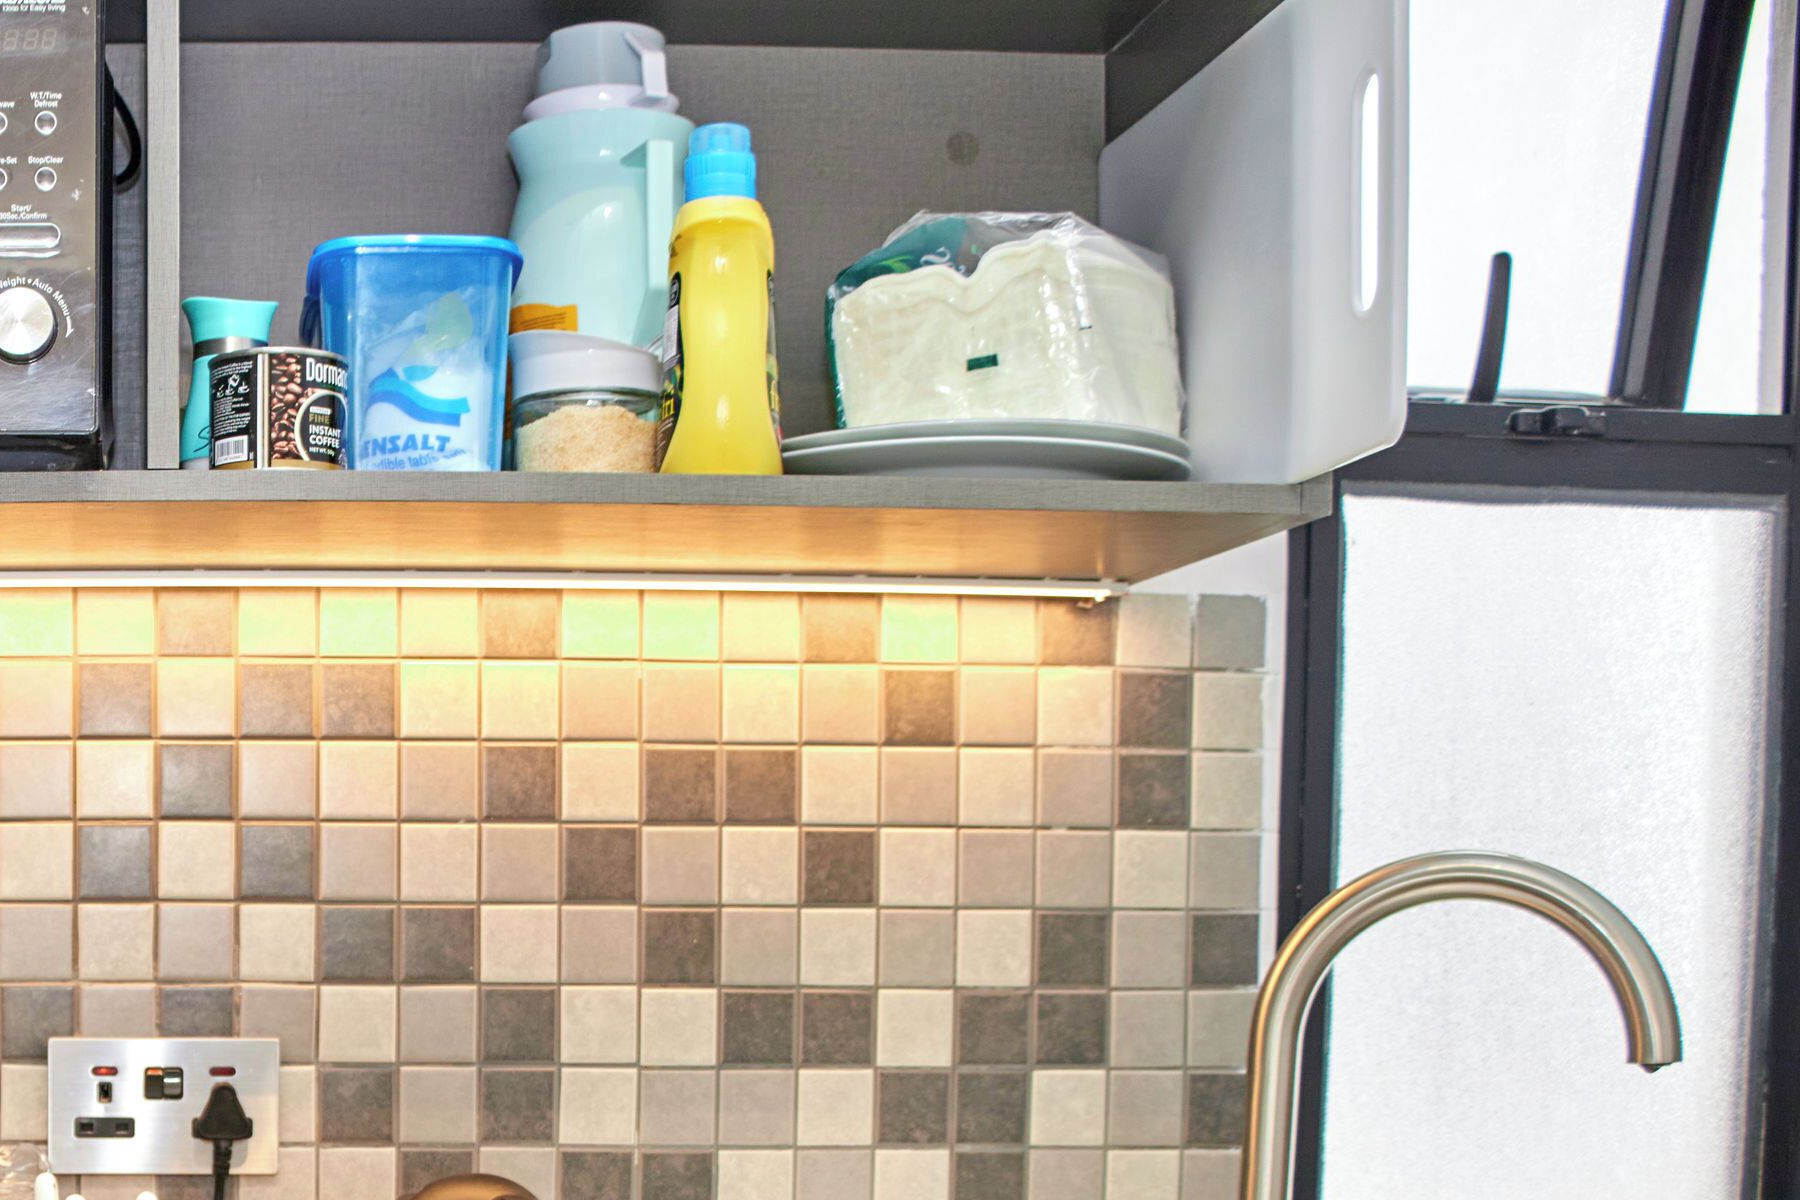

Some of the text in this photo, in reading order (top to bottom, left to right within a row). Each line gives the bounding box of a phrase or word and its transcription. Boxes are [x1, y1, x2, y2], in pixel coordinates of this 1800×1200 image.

[34, 100, 58, 108] Defrost
[28, 155, 64, 165] Stop/Clear
[31, 278, 53, 294] Auto
[52, 290, 71, 316] Menu
[309, 424, 342, 439] INSTANT
[309, 435, 340, 449] COFFEE
